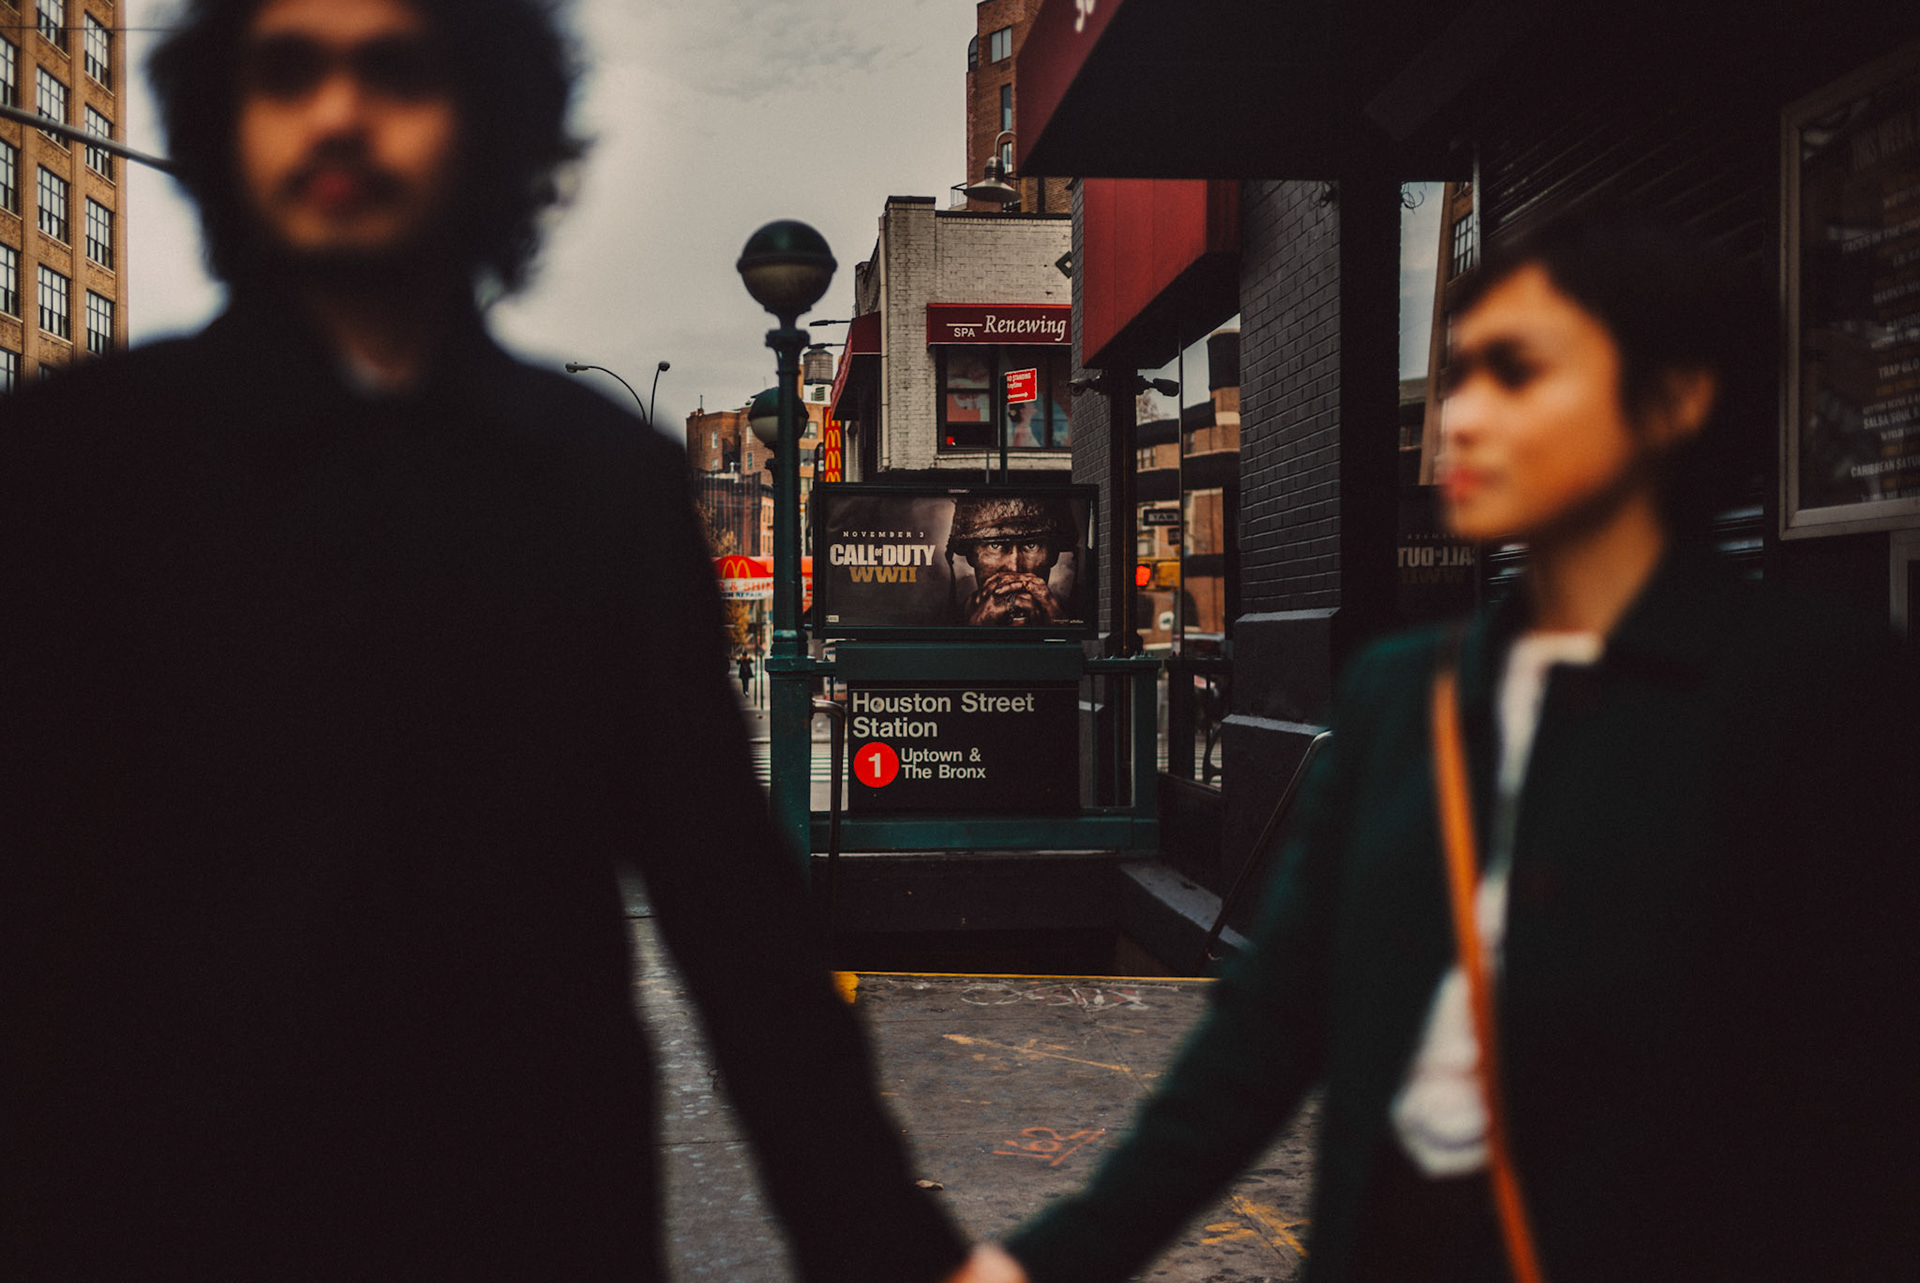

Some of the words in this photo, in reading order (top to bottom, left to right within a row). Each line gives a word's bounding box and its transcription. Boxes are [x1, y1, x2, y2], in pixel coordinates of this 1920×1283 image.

[954, 327, 976, 338] SPA
[984, 315, 1067, 342] Renewing
[1863, 414, 1890, 430] SALSA
[1850, 459, 1896, 478] CARIBBEAN
[829, 543, 878, 566] CALL
[882, 544, 936, 566] DUTY
[848, 566, 918, 583] WWII
[852, 692, 951, 713] Houston
[961, 691, 1035, 713] Street
[852, 716, 938, 738] Station
[868, 752, 882, 779] 1
[901, 747, 963, 766] Uptown
[968, 747, 982, 762] &
[901, 764, 932, 779] The
[939, 764, 987, 779] Bronx
